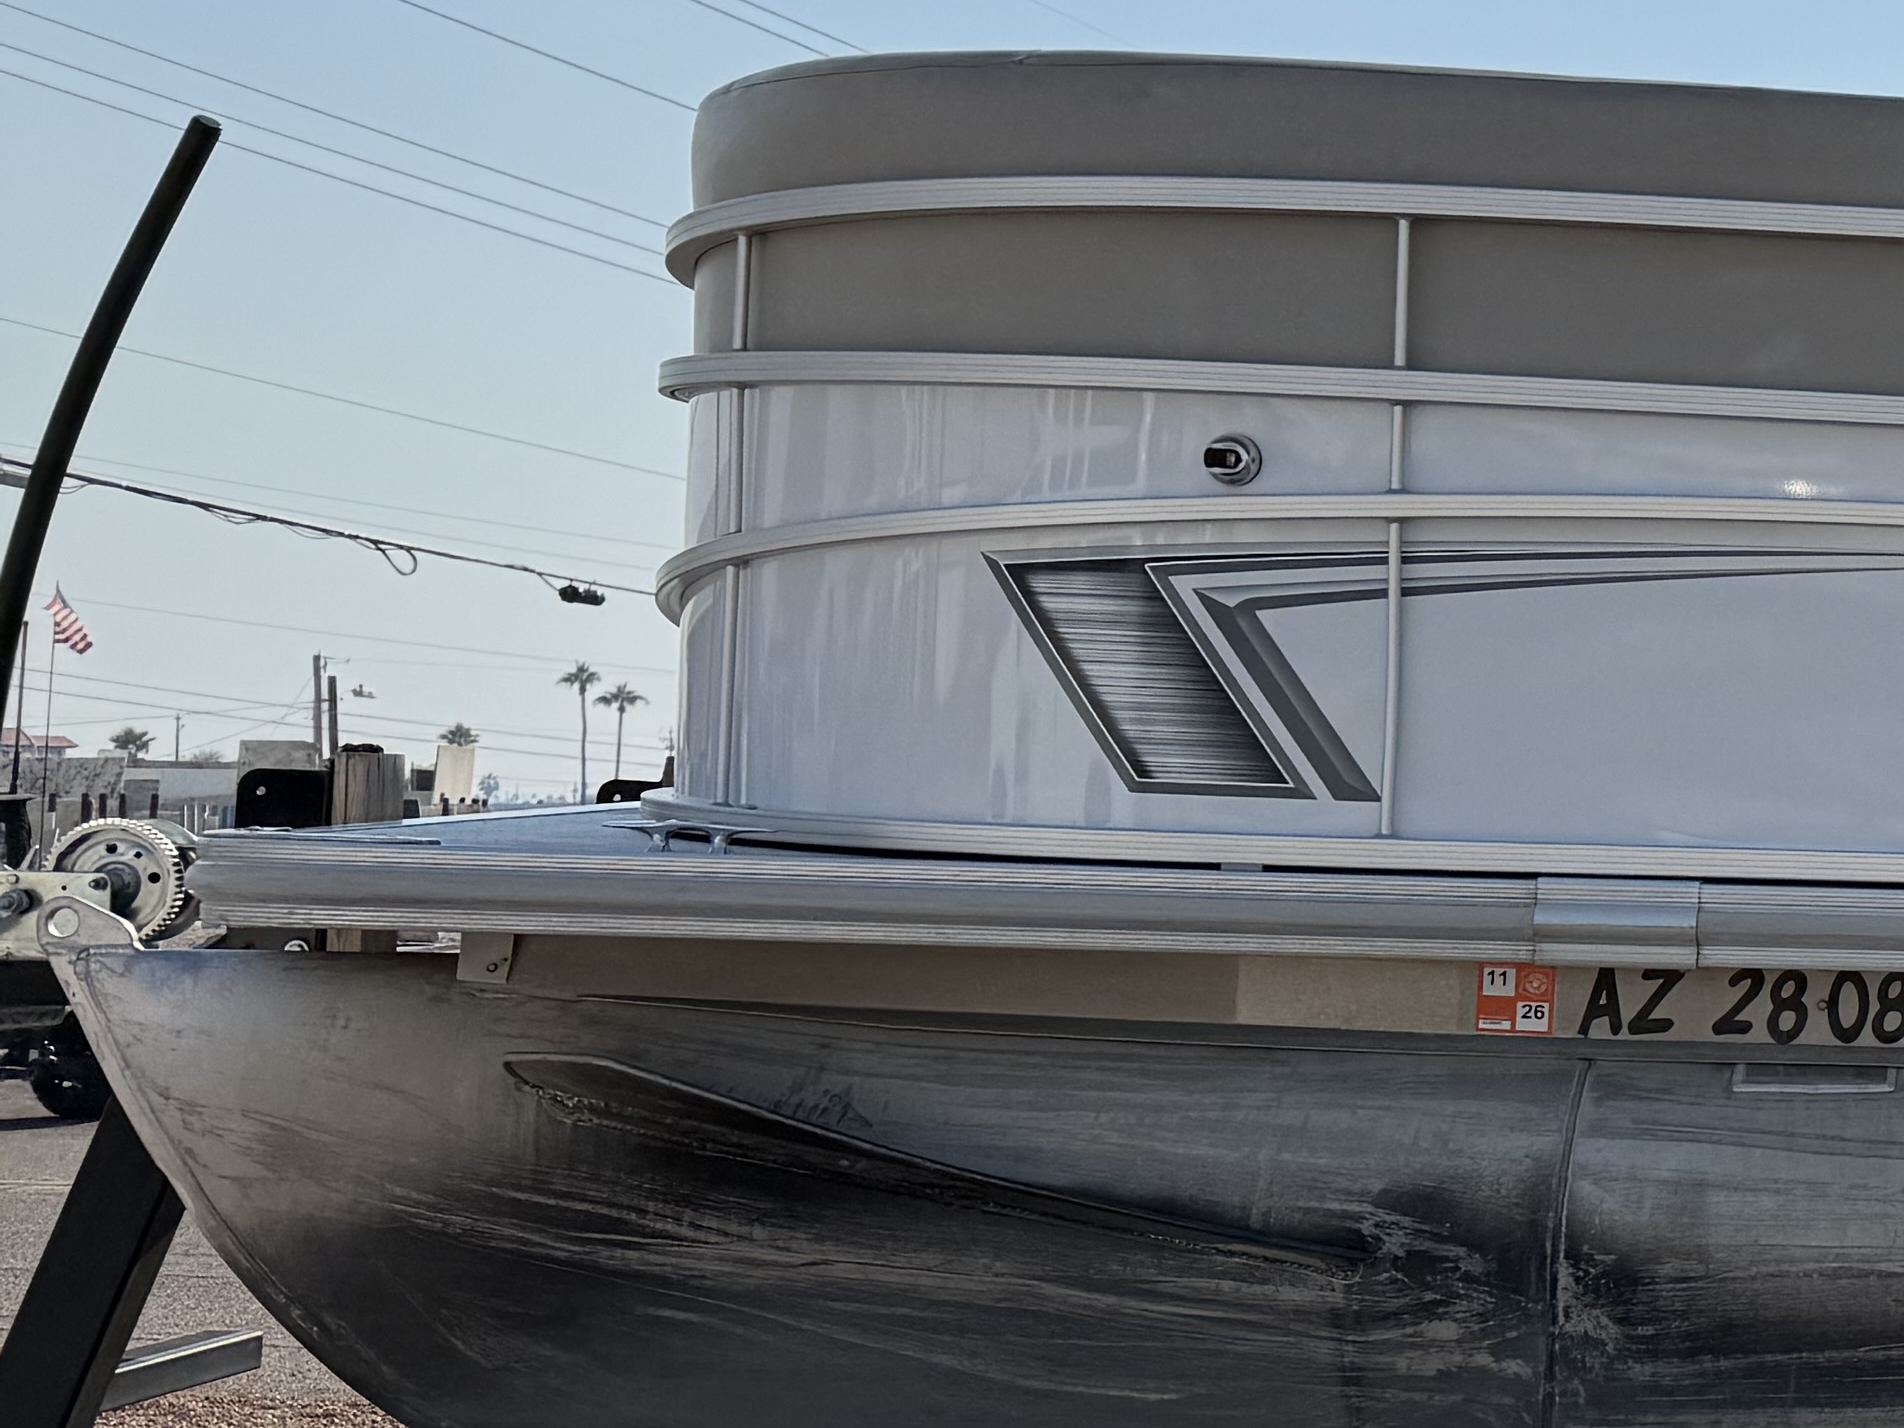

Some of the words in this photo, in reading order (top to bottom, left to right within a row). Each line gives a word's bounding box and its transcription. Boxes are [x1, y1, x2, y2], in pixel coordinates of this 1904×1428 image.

[1487, 969, 1508, 987] 11
[1577, 967, 1686, 1038] AZ
[1521, 1004, 1545, 1020] 26
